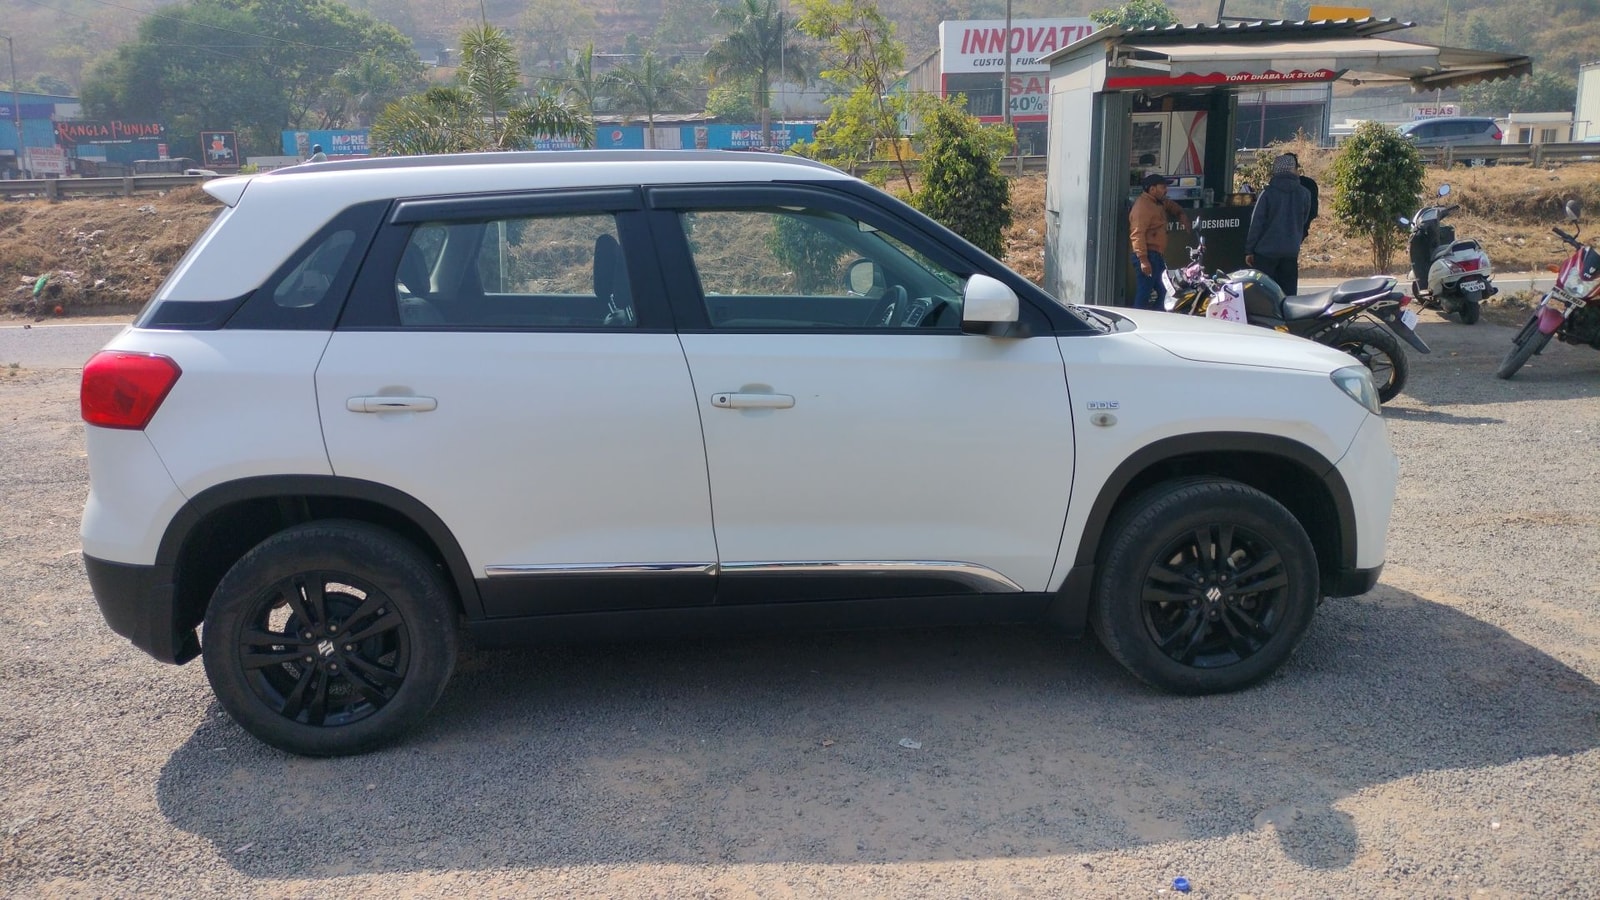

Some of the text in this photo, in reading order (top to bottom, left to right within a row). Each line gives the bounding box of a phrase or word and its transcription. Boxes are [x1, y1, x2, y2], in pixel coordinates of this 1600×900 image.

[973, 58, 1006, 67] CUSTO
[1010, 96, 1043, 111] 40%
[1418, 107, 1454, 115] TEJAS
[57, 120, 160, 142] RANGLA PUNJAB
[1201, 218, 1240, 229] DESIGNED
